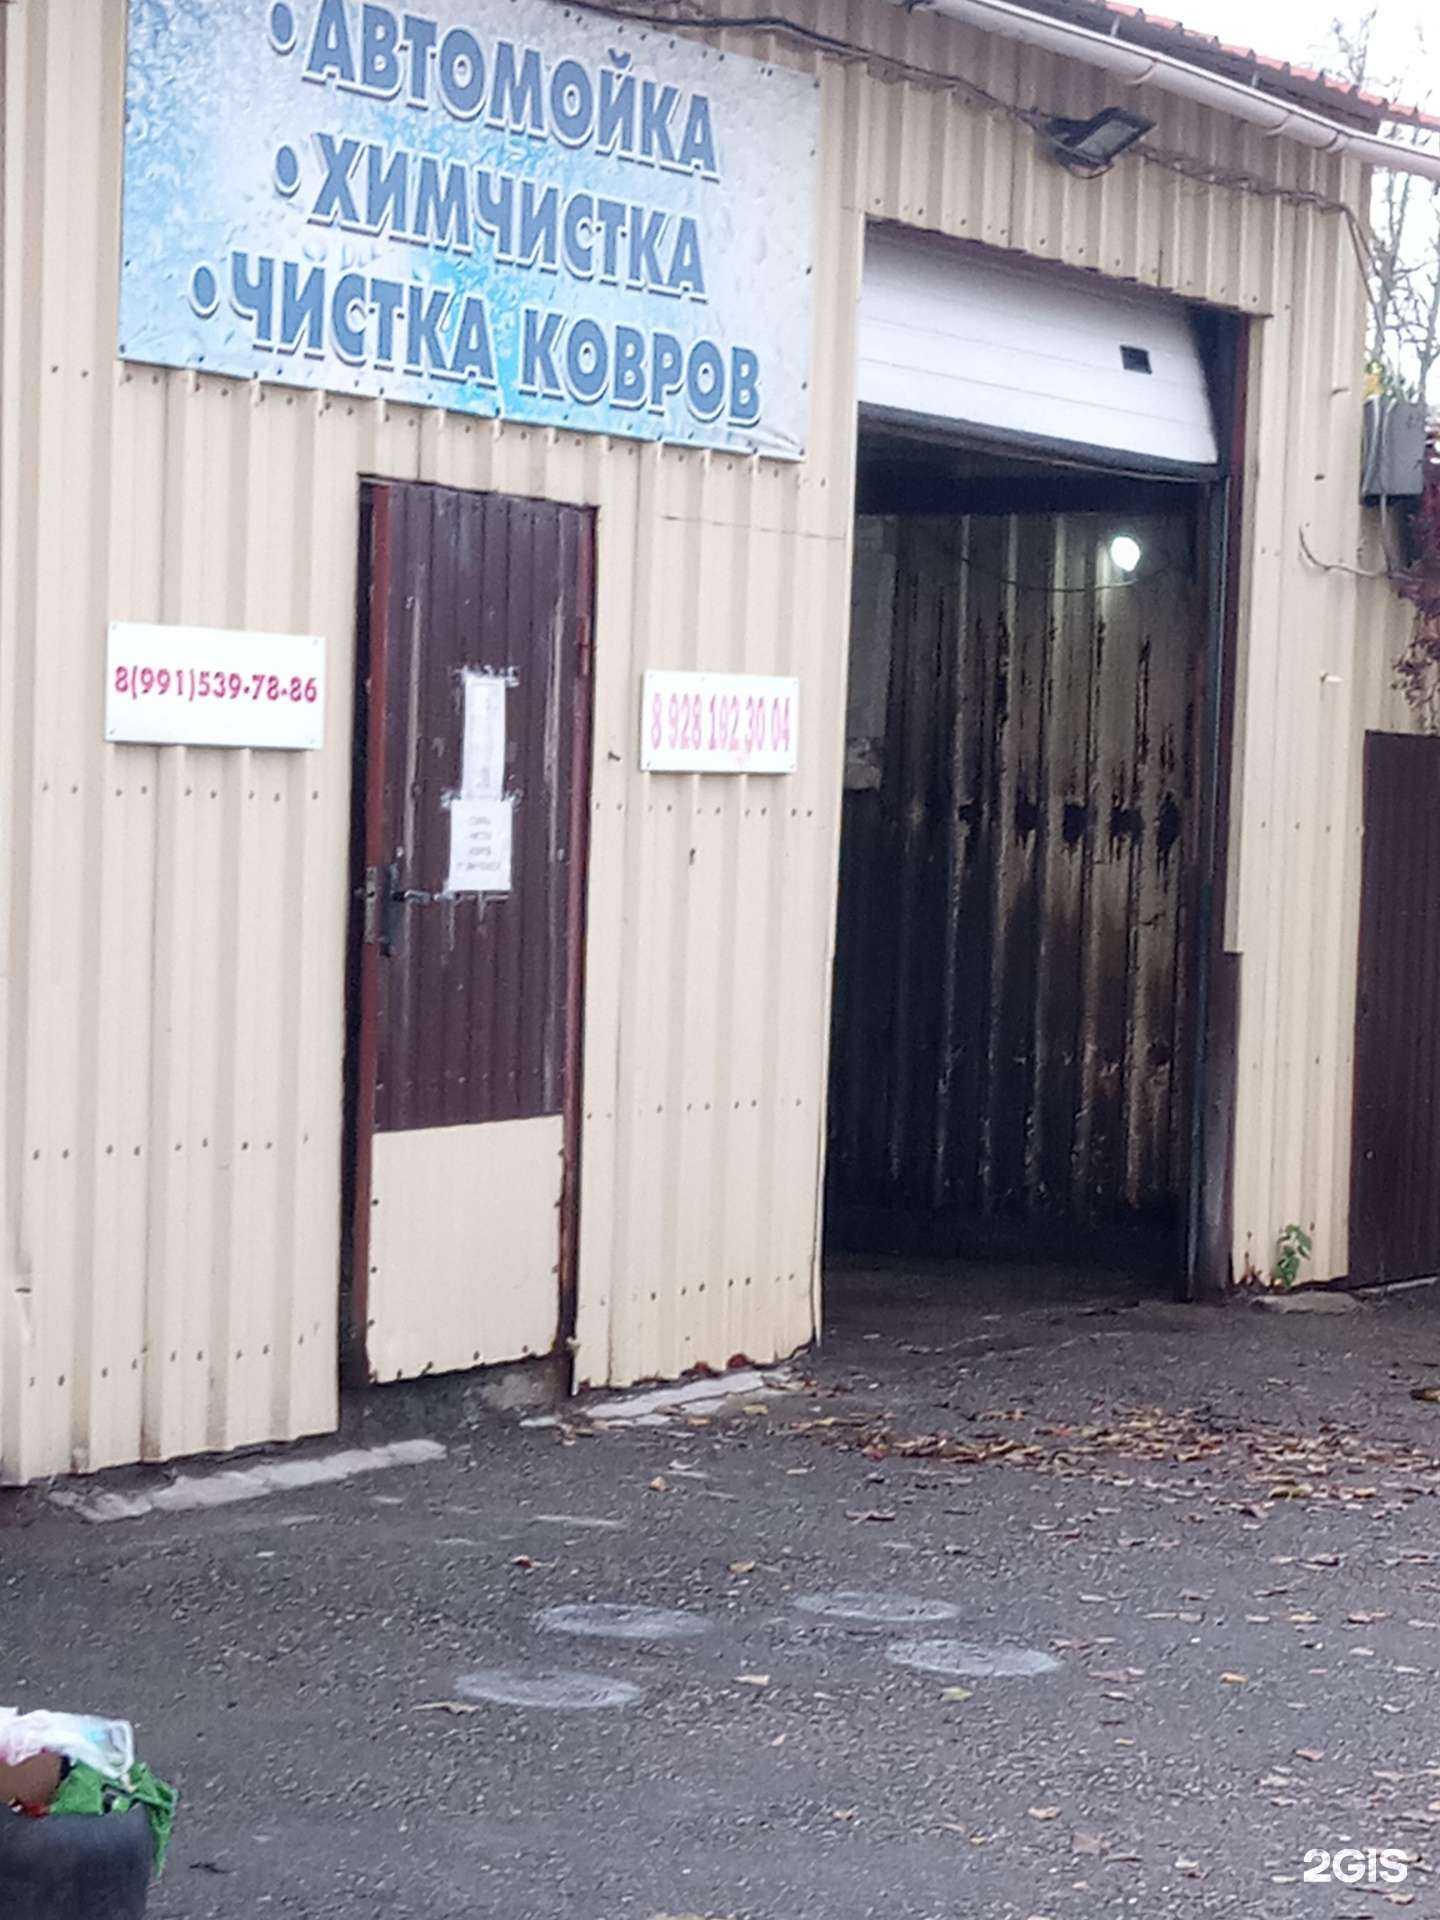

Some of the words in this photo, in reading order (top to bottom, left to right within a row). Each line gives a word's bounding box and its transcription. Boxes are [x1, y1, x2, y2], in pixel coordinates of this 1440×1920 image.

[302, 0, 720, 182] АВТОМОЙКА
[307, 132, 709, 302] ХИМЧИСТКА
[229, 250, 496, 389] ЧИСТКА
[520, 306, 761, 427] КОВРОВ
